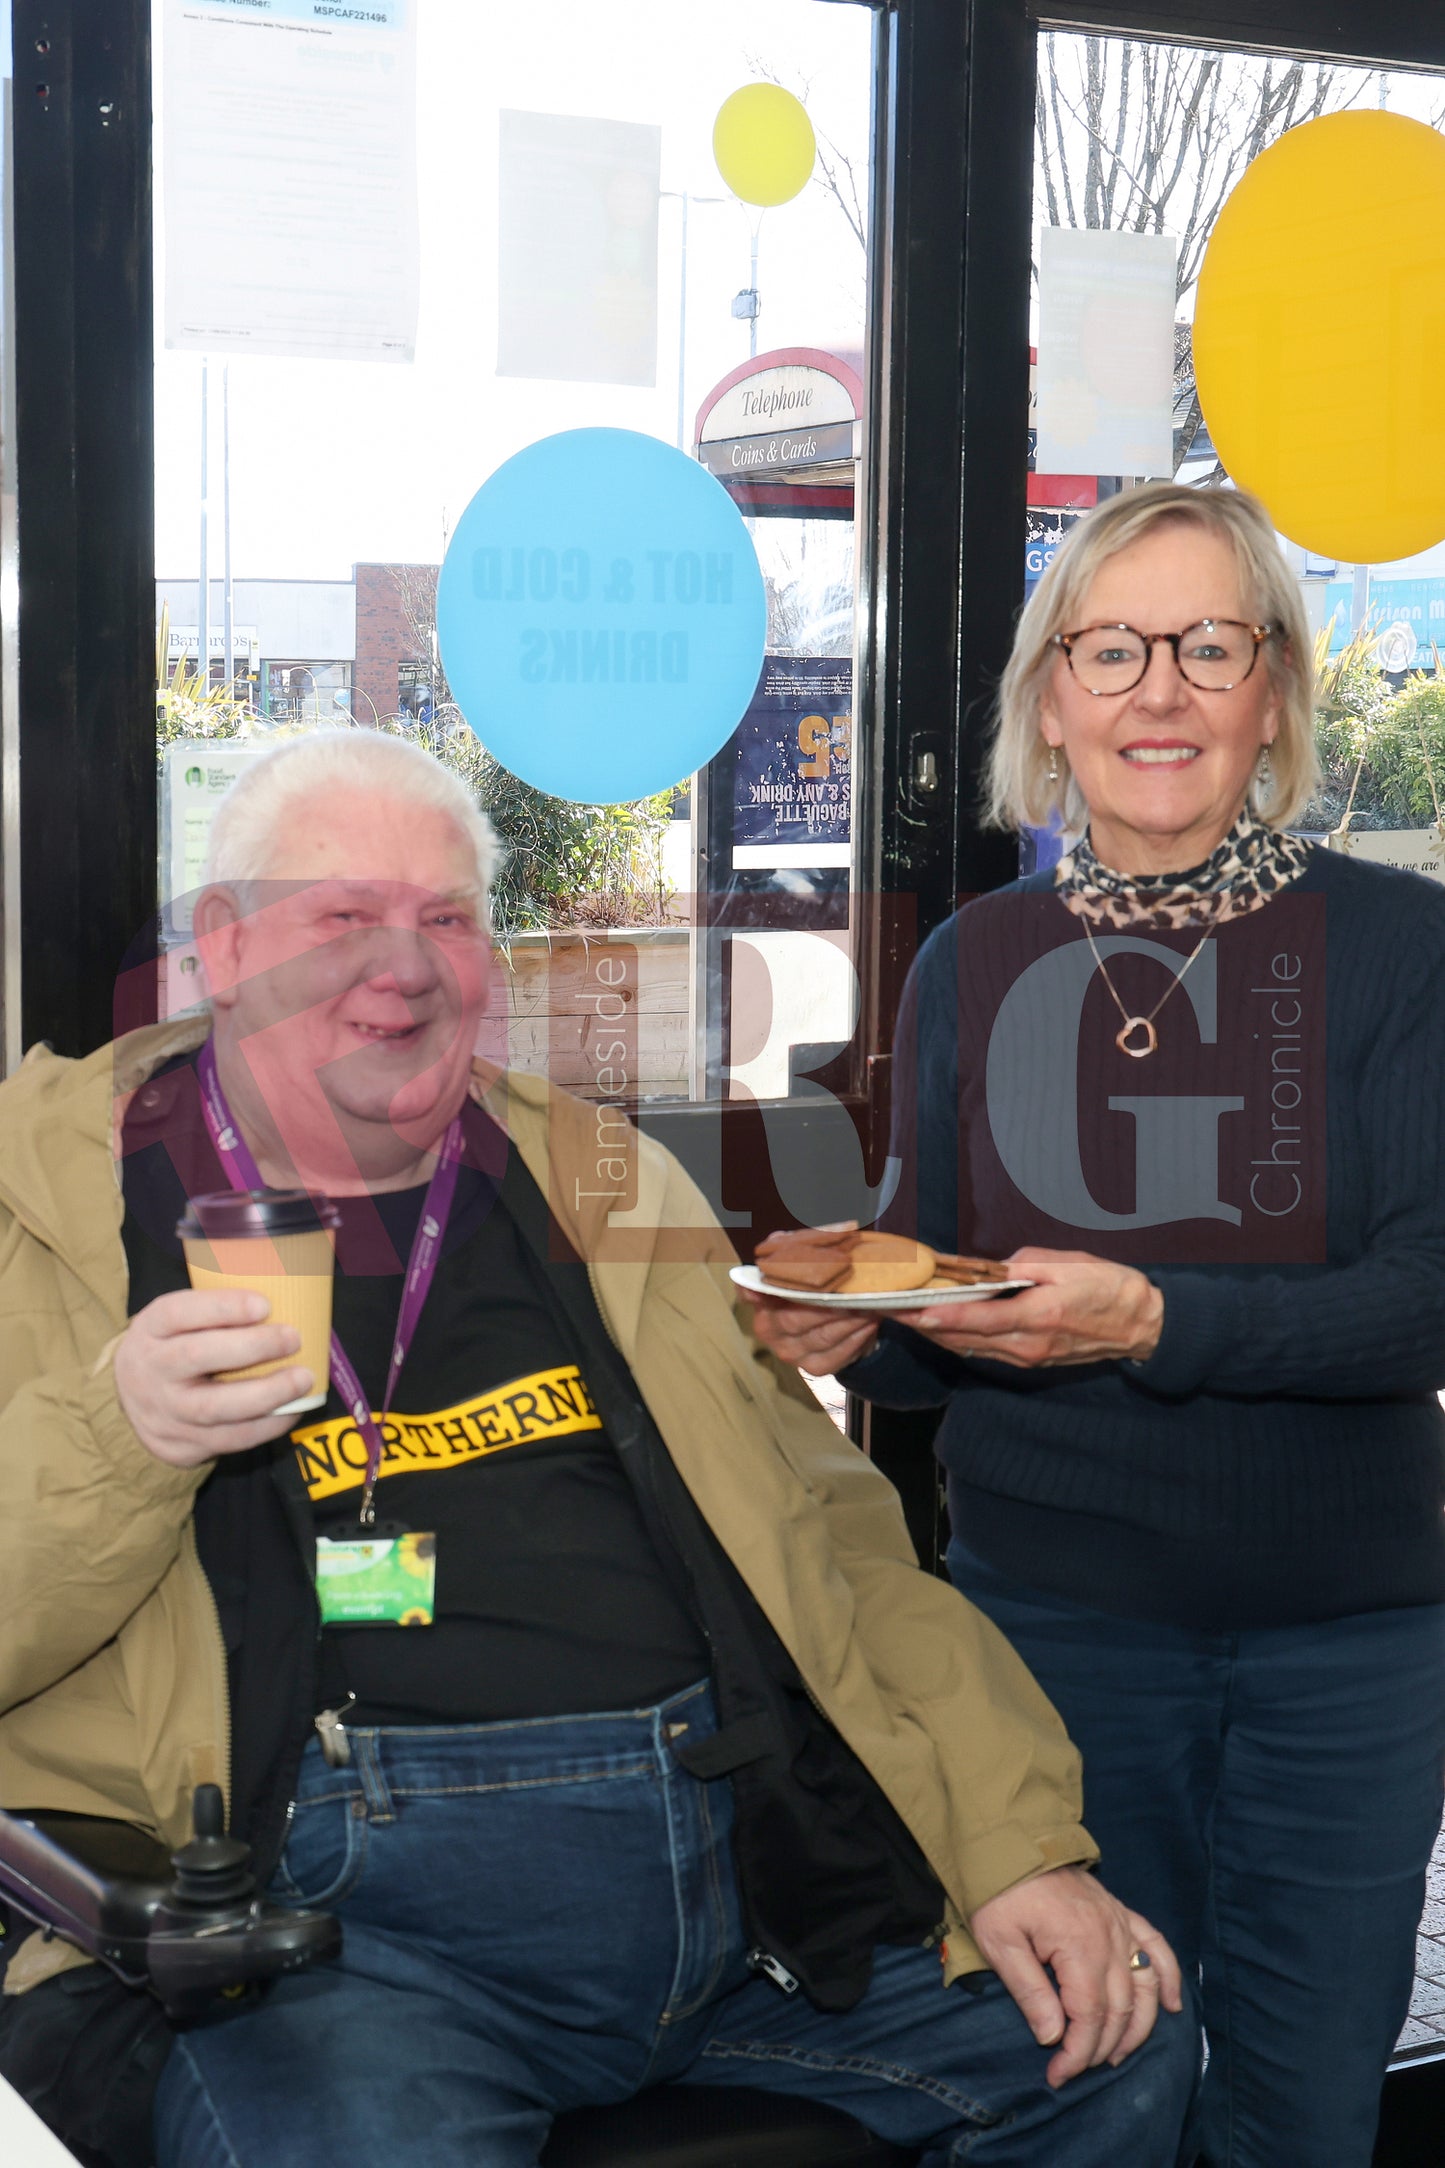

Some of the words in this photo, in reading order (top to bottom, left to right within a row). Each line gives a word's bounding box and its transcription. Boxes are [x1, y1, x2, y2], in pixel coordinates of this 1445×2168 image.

[314, 5, 387, 23] MSPCAF221496
[741, 384, 813, 417] Telephone
[731, 445, 764, 468] Coins
[766, 441, 778, 462] &
[780, 436, 817, 459] Cards
[751, 785, 795, 803] DRINK
[799, 785, 827, 802] ANY
[1421, 860, 1439, 872] are
